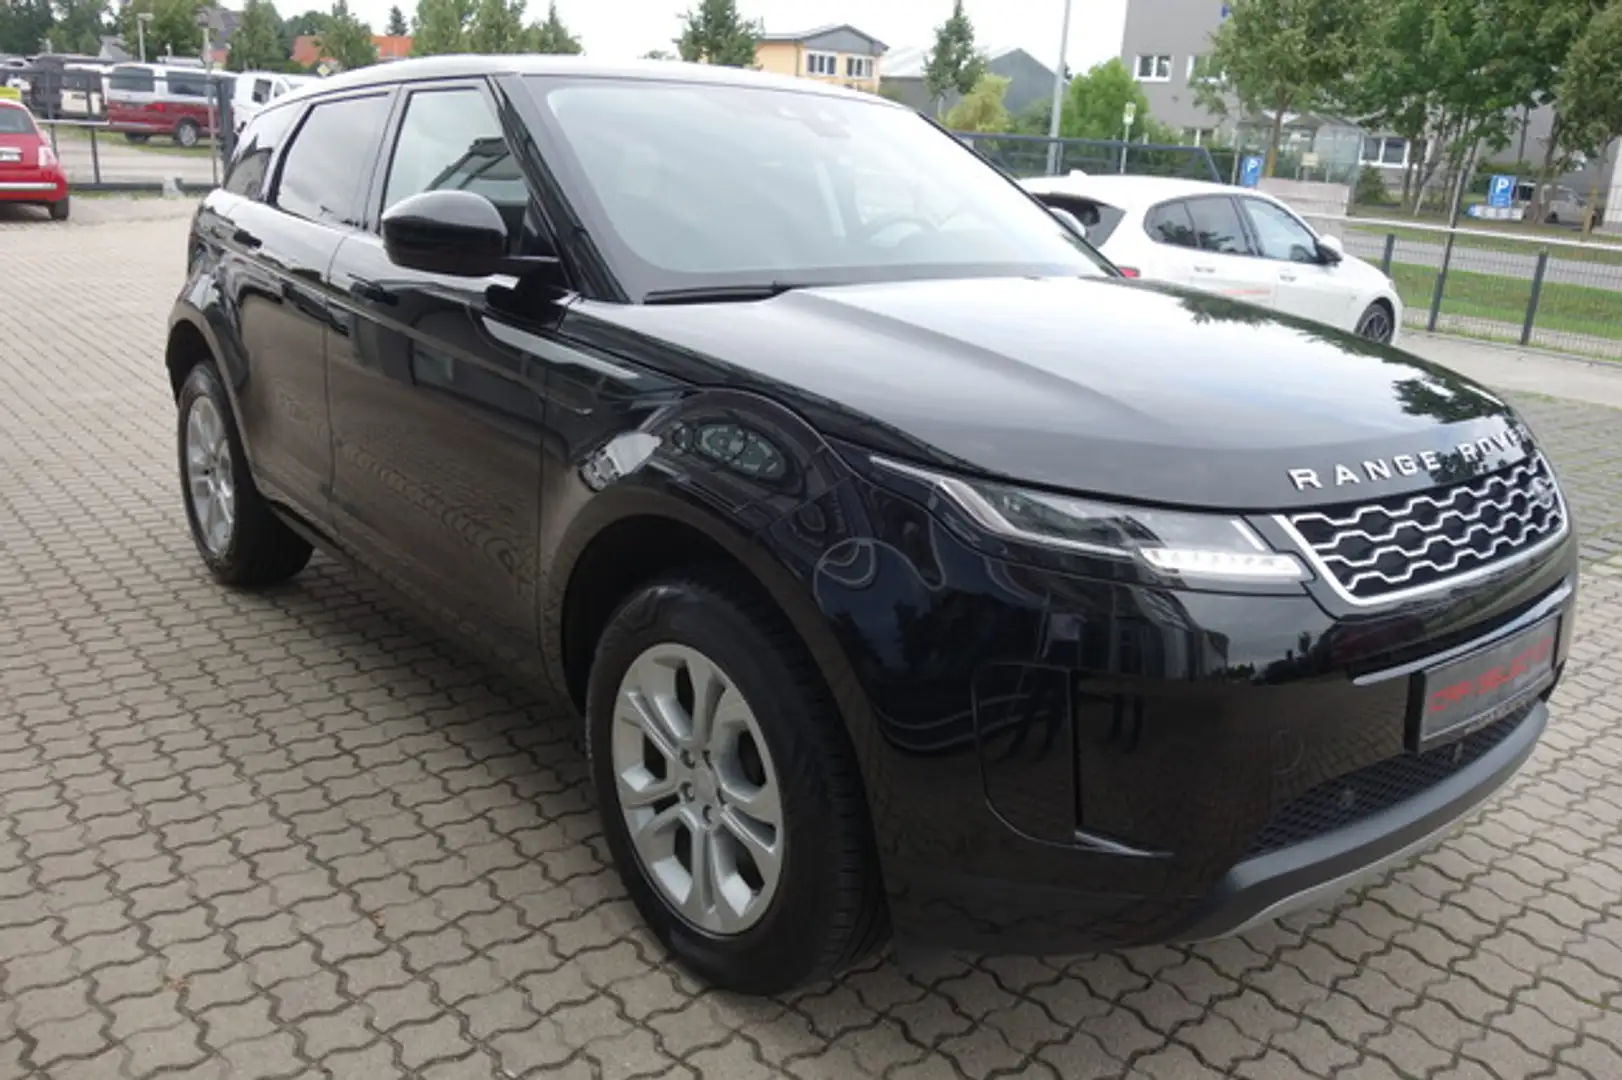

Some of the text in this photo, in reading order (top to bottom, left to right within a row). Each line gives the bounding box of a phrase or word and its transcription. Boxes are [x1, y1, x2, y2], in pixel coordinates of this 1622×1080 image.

[1247, 157, 1258, 172] P
[1495, 177, 1509, 193] P
[1287, 450, 1442, 491] RANGE
